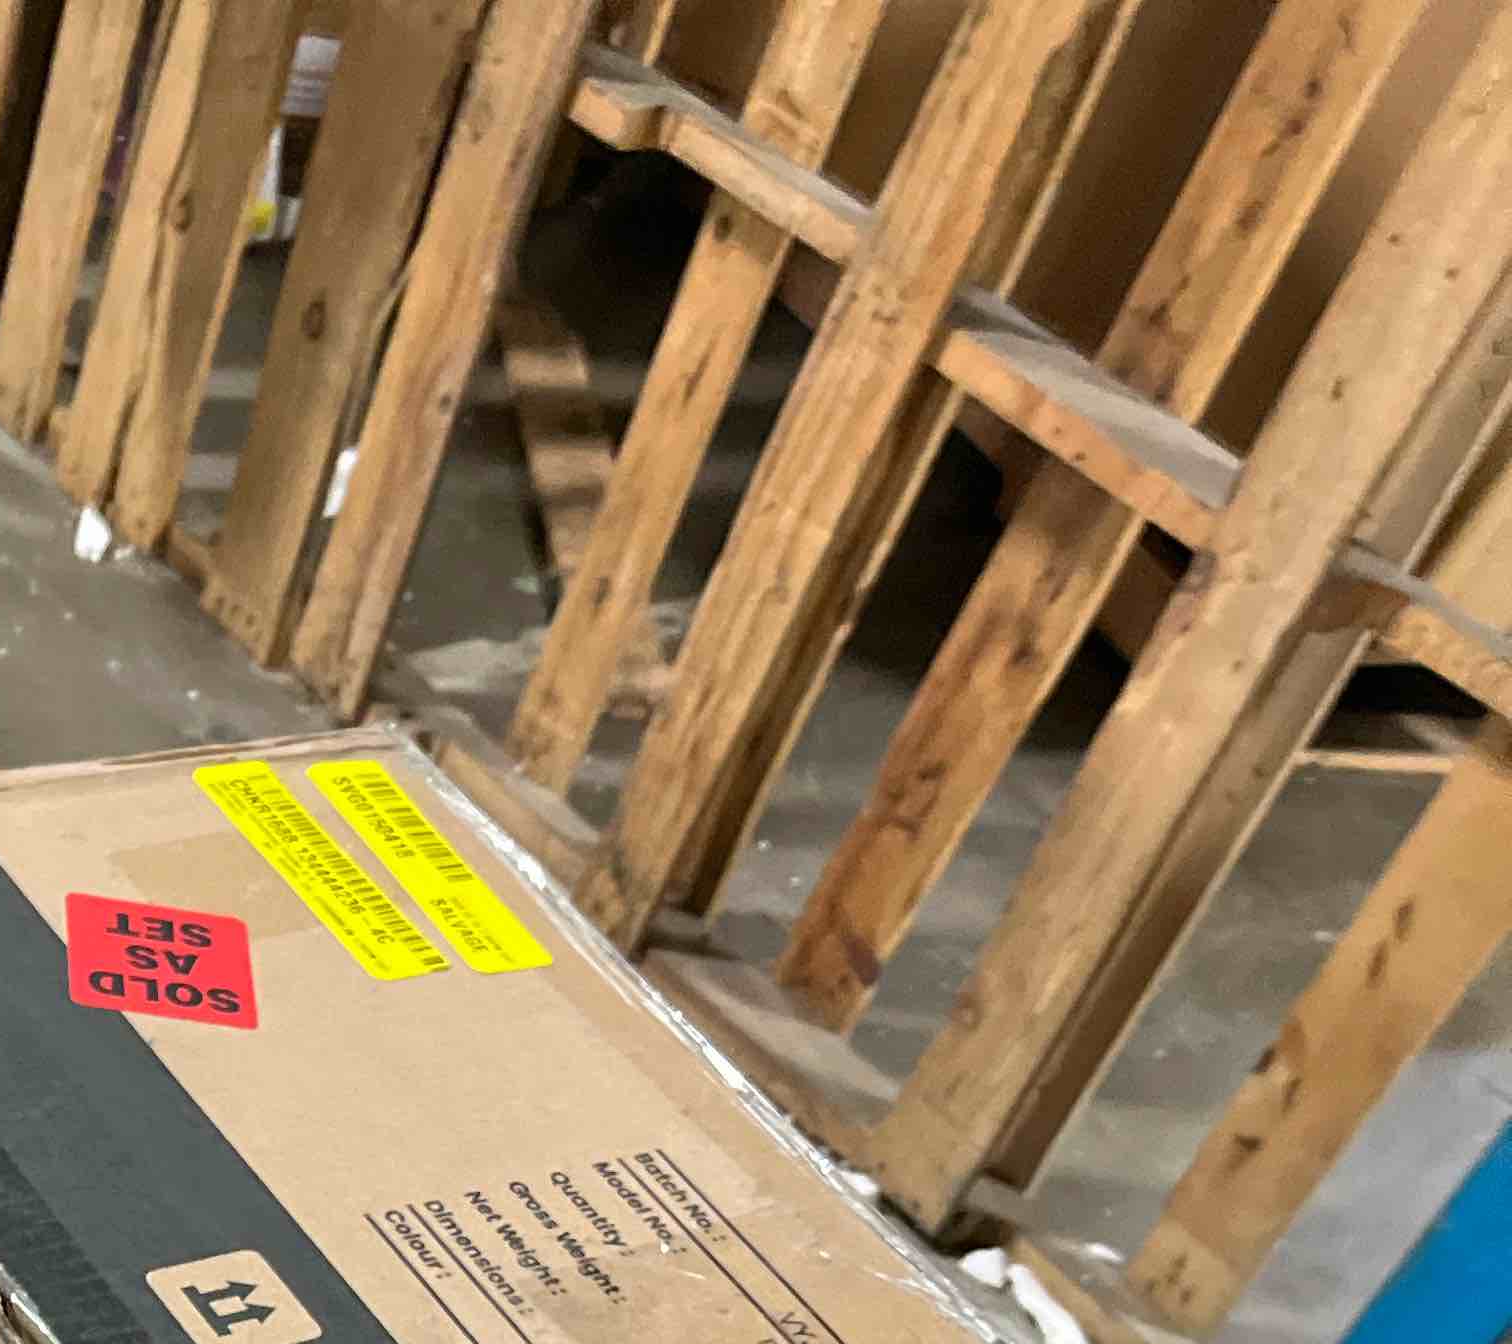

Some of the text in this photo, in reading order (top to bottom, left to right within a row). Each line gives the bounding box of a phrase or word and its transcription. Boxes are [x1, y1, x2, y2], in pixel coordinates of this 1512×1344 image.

[104, 911, 212, 948] SET
[430, 898, 490, 954] SALVAGE
[125, 944, 199, 975] AS
[89, 969, 241, 1014] SOLD
[593, 1161, 649, 1222] Model
[634, 1152, 688, 1204] Batch
[464, 1190, 502, 1224] Net
[509, 1180, 558, 1230] Gross
